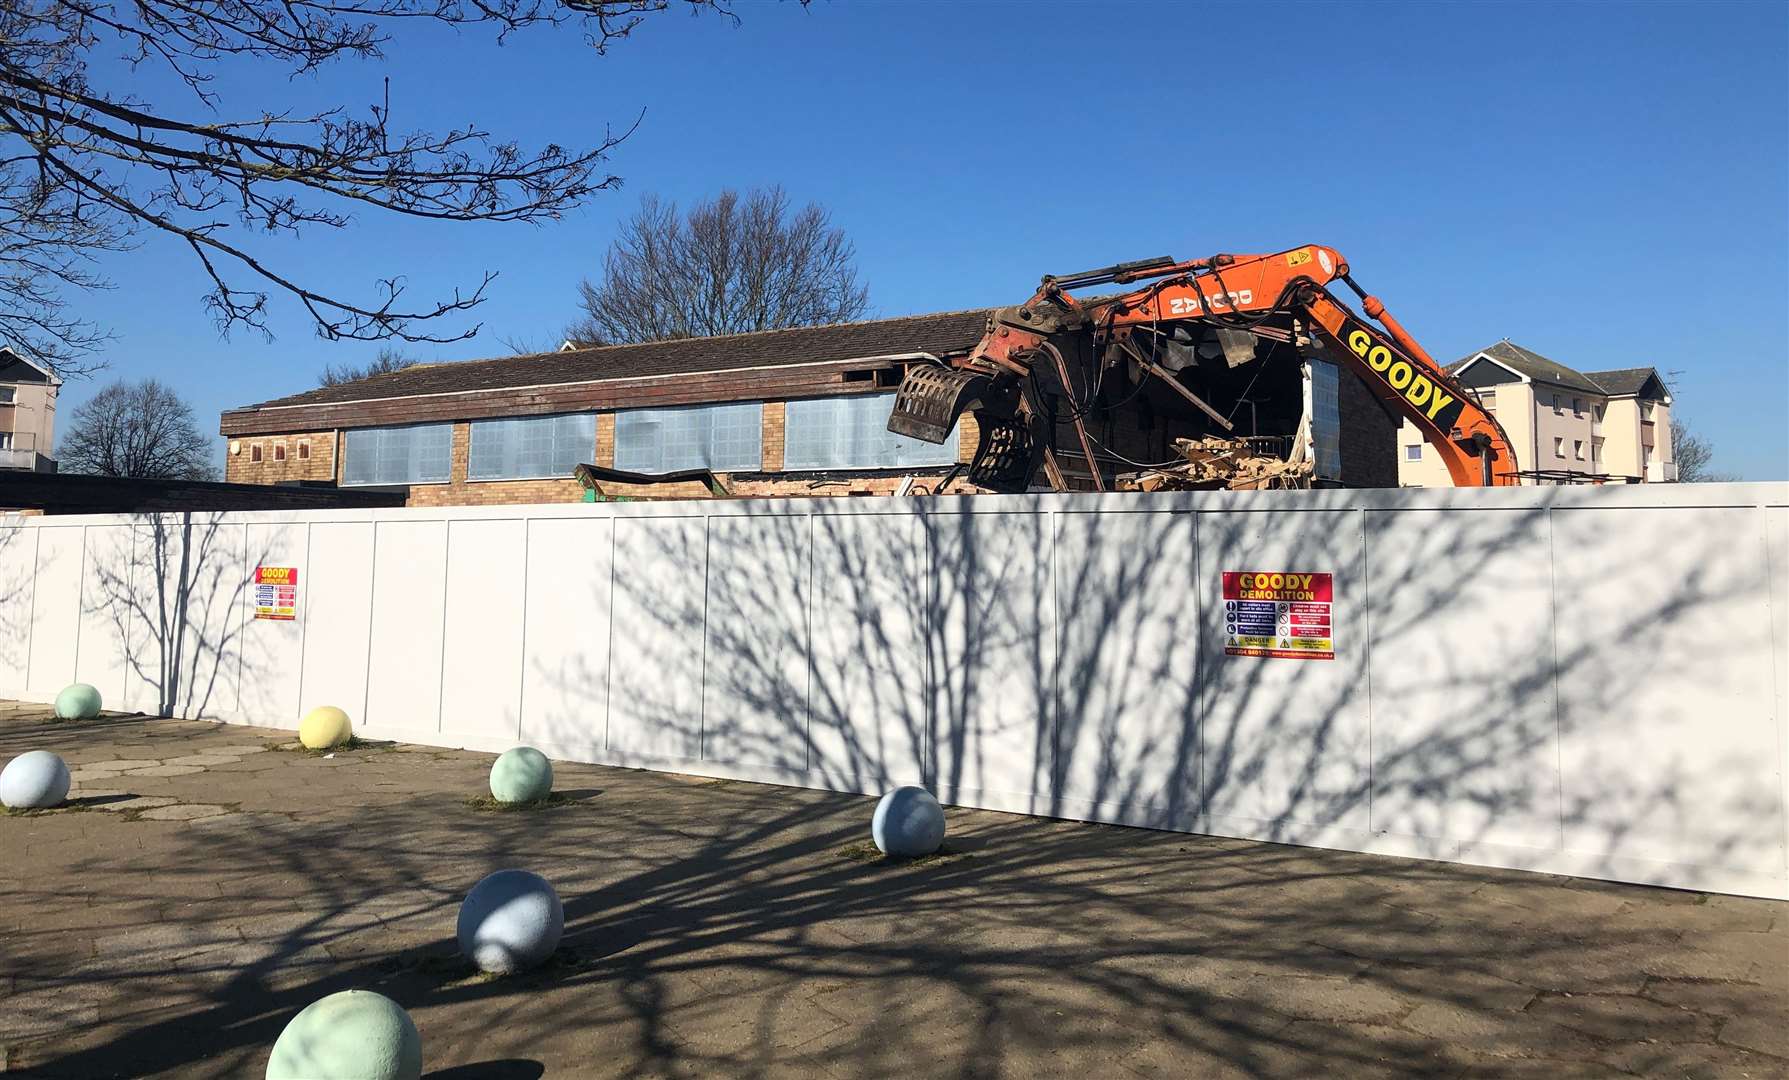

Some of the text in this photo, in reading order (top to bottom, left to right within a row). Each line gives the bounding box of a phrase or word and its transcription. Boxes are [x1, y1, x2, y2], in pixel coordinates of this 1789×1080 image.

[1348, 329, 1454, 421] GOODY
[261, 568, 289, 578] GOODY
[1239, 573, 1313, 590] GOODY
[1240, 590, 1314, 601] DEMOLITION
